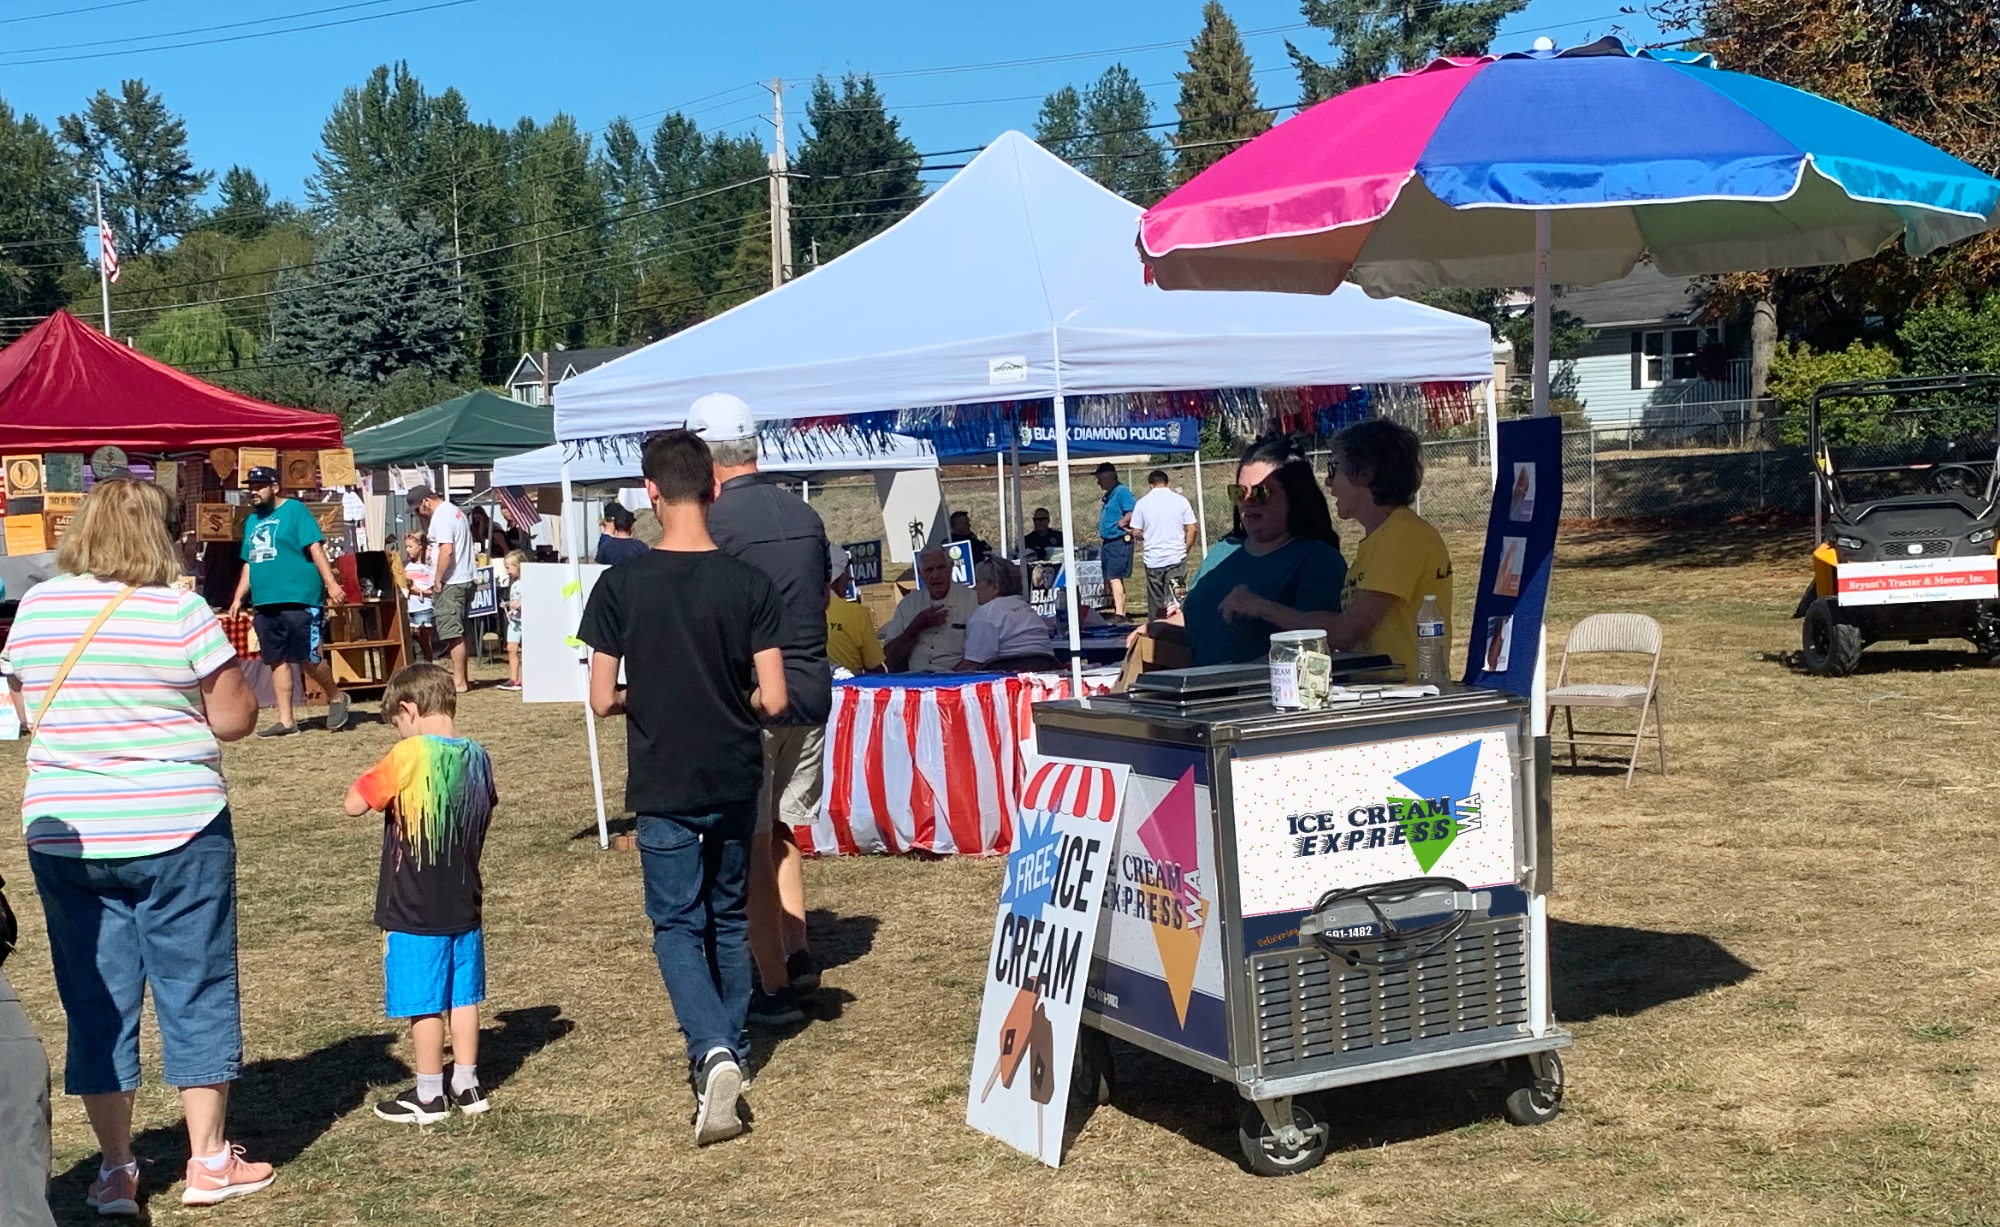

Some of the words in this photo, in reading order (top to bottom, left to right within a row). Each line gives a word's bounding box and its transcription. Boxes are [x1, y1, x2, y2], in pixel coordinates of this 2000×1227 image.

[1034, 427, 1072, 441] BLAK
[1074, 427, 1127, 441] DIAMOND
[1130, 427, 1166, 441] POLICE
[1031, 587, 1060, 604] BLAC
[1849, 579, 1886, 591] Bryant's
[1888, 578, 1921, 588] Tractor
[1923, 575, 1931, 585] &
[1934, 575, 1968, 586] Mower,
[1969, 574, 1986, 584] Inc.
[830, 622, 843, 632] YS
[1031, 603, 1056, 616] OLIC
[1287, 811, 1334, 835] ICE
[1347, 795, 1450, 827] CREAM
[1292, 819, 1450, 858] EXPRESS
[1455, 793, 1481, 836] WA
[1015, 843, 1054, 899] FREE
[1051, 835, 1101, 913] ICE
[1122, 852, 1181, 894] CREAM
[1101, 880, 1183, 930] EXPRESS
[1184, 867, 1203, 930] WA
[1257, 927, 1300, 947] Delivering
[1325, 926, 1372, 938] 591-1482
[995, 911, 1083, 1005] CREAM
